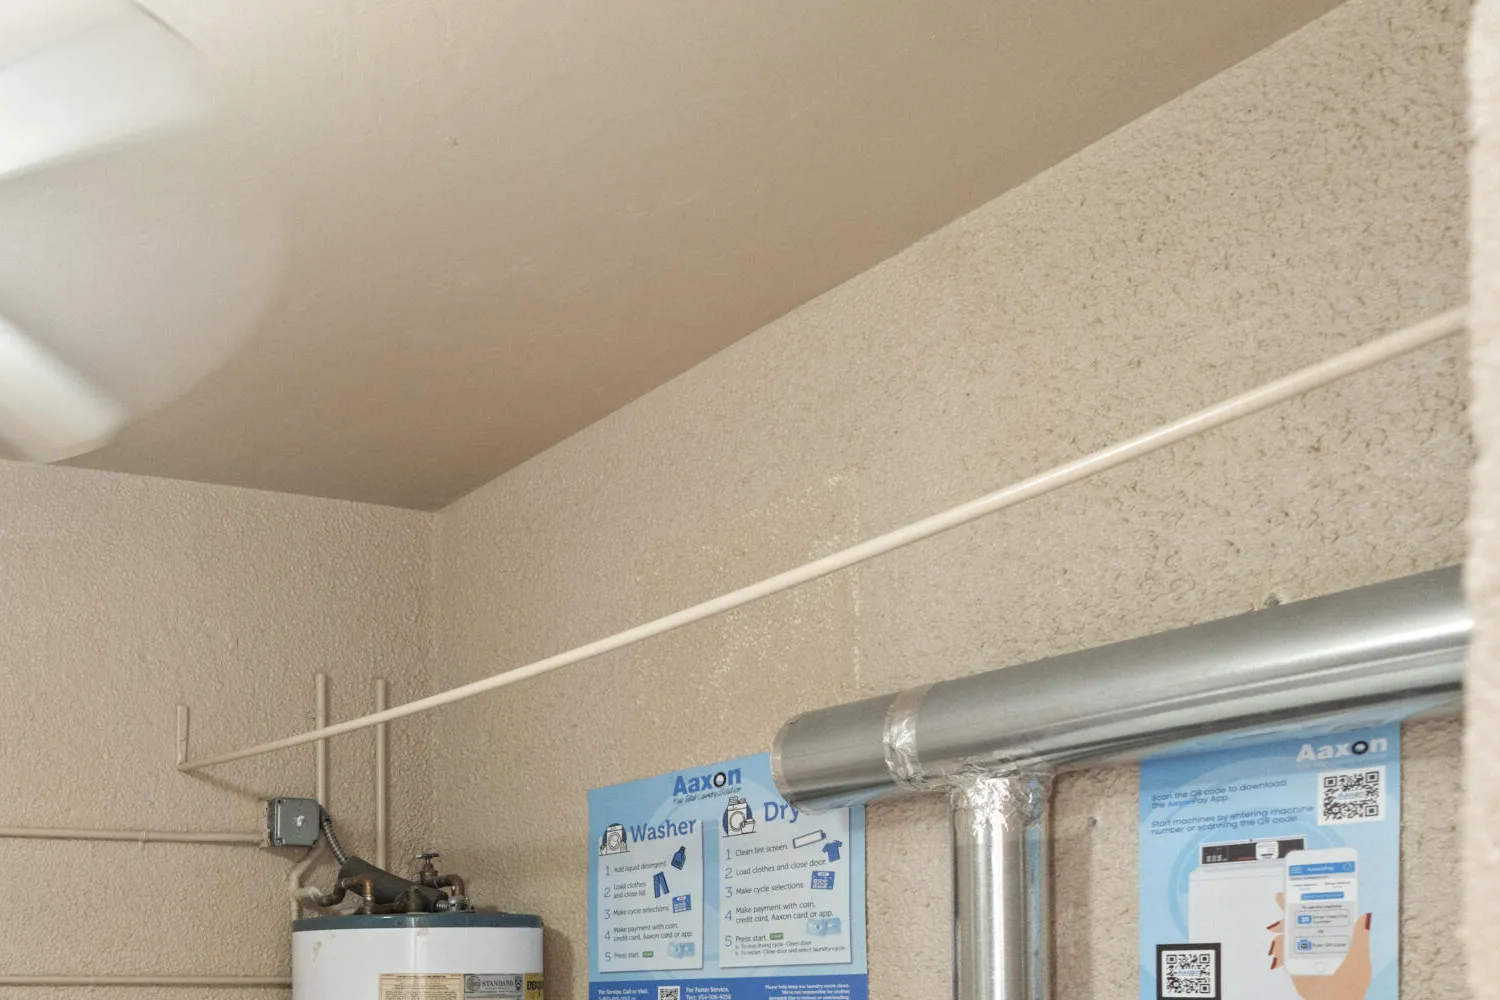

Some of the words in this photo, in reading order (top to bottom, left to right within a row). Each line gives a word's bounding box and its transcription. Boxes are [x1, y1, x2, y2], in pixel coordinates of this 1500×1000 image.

[1296, 738, 1388, 761] Aaxon
[673, 768, 742, 796] Aaxon
[1204, 788, 1226, 796] code
[1239, 780, 1287, 791] download
[764, 801, 799, 823] Dry
[1173, 815, 1215, 826] machines
[1218, 814, 1229, 822] by
[1230, 810, 1268, 820] entering
[1270, 805, 1315, 815] machine
[630, 819, 696, 843] Washer
[1151, 827, 1185, 835] number
[1198, 821, 1238, 831] scanning
[726, 849, 731, 860] 1
[605, 866, 610, 876] 1
[724, 867, 733, 879] 2
[752, 865, 774, 874] clothes
[604, 887, 611, 898] 2
[725, 886, 732, 898] 3
[754, 884, 770, 894] cycle
[604, 909, 610, 920] 3
[725, 910, 732, 920] 4
[753, 904, 781, 913] payment
[604, 931, 611, 940] 4
[725, 935, 732, 947] 5
[605, 952, 611, 962] 5
